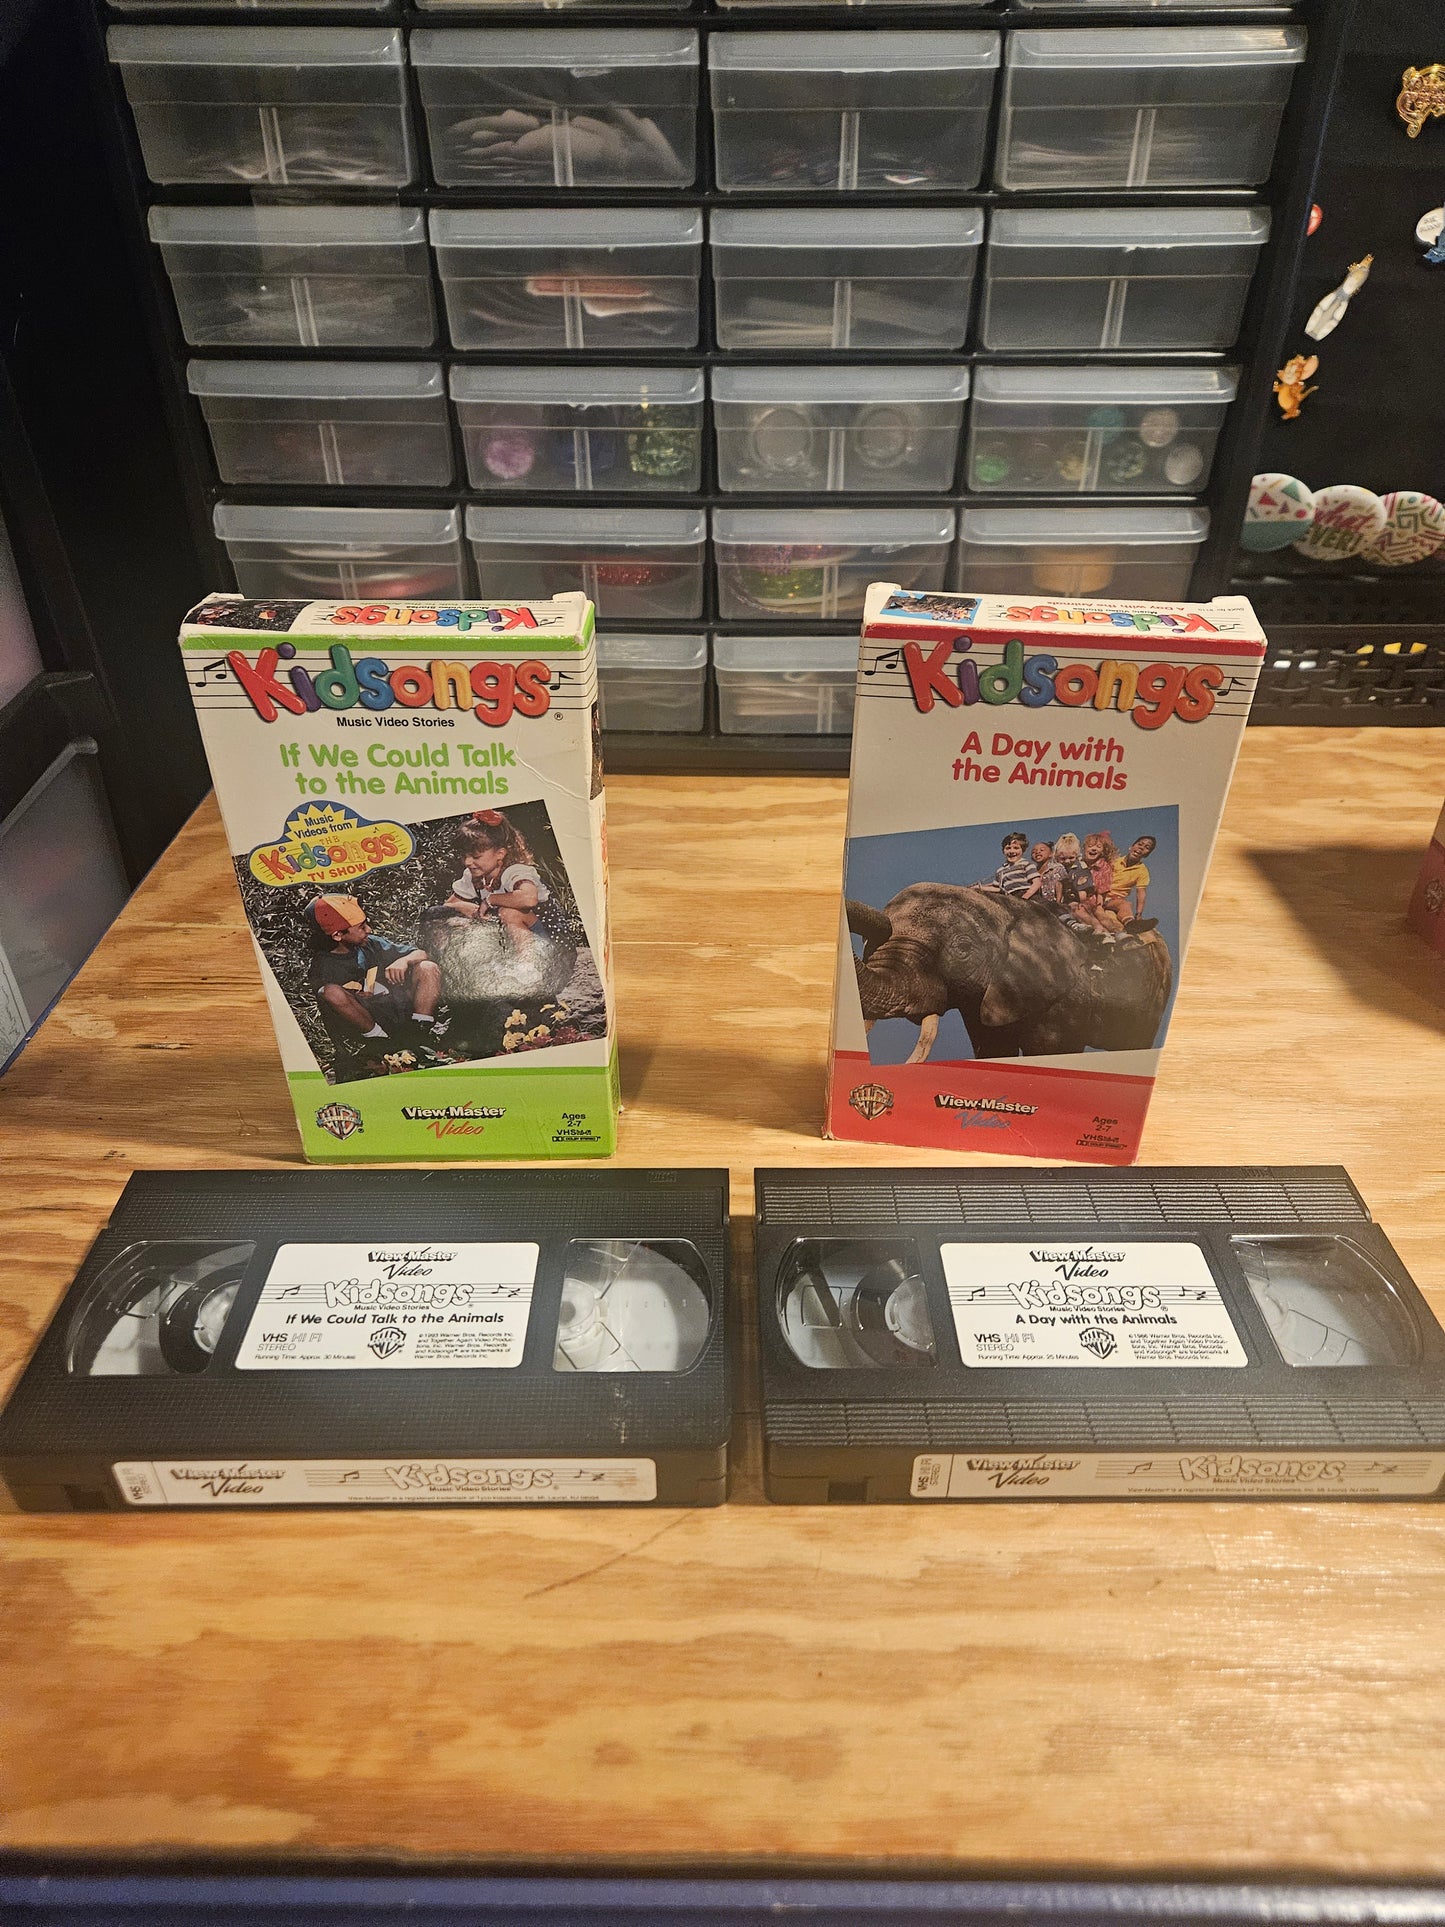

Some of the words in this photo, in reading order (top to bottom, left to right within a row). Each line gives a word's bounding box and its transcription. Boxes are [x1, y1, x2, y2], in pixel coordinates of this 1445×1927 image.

[331, 605, 538, 631] Kidsongs
[1006, 606, 1220, 633] Kidsongs
[227, 642, 552, 726] Kidsongs
[903, 636, 1224, 730] Kidsongs
[336, 716, 371, 728] Music
[375, 716, 408, 728] Video
[412, 716, 454, 728] Stories
[280, 743, 300, 768] If
[306, 743, 361, 768] We
[367, 743, 450, 768] Could
[457, 743, 517, 768] Talk
[961, 732, 982, 755] A
[992, 733, 1050, 761] Day
[1060, 736, 1124, 763] with
[952, 758, 1000, 783] the
[1008, 761, 1128, 791] Animals
[296, 772, 327, 796] to
[335, 772, 390, 796] the
[394, 772, 509, 796] Animals
[304, 814, 334, 828] Music
[294, 828, 328, 840] Videos
[329, 822, 352, 834] from
[320, 836, 340, 846] THE
[259, 834, 398, 880] Kidsongs
[308, 872, 326, 882] TV
[329, 862, 368, 878] SHOW
[401, 1104, 506, 1120] View-Master
[934, 1093, 1039, 1116] View-Master
[562, 1112, 586, 1120] Ages
[1092, 1116, 1118, 1125] Ages
[427, 1119, 484, 1140] Video
[368, 1250, 458, 1262] View-Master
[1030, 1250, 1126, 1262] View-Master
[383, 1262, 433, 1280] Video
[1056, 1262, 1109, 1280] Video
[324, 1278, 474, 1310] Kidsongs
[1008, 1280, 1161, 1310] Kidsongs
[286, 1314, 298, 1325] If
[302, 1314, 322, 1325] We
[327, 1314, 366, 1325] Could
[371, 1314, 398, 1325] Talk
[402, 1314, 416, 1325] to
[421, 1314, 444, 1325] the
[448, 1314, 504, 1325] Animals
[1016, 1314, 1026, 1324] A
[1029, 1314, 1056, 1326] Day
[1059, 1314, 1090, 1325] with
[1094, 1314, 1119, 1325] the
[1122, 1314, 1178, 1325] Animals
[262, 1333, 288, 1342] VHS
[974, 1333, 1001, 1343] VHS
[257, 1343, 296, 1351] STEREO
[976, 1343, 1014, 1351] STEREO
[385, 1463, 554, 1490] Kidsongs
[1180, 1454, 1346, 1482] Kidsongs
[201, 1480, 264, 1497] Video
[988, 1472, 1050, 1490] Video
